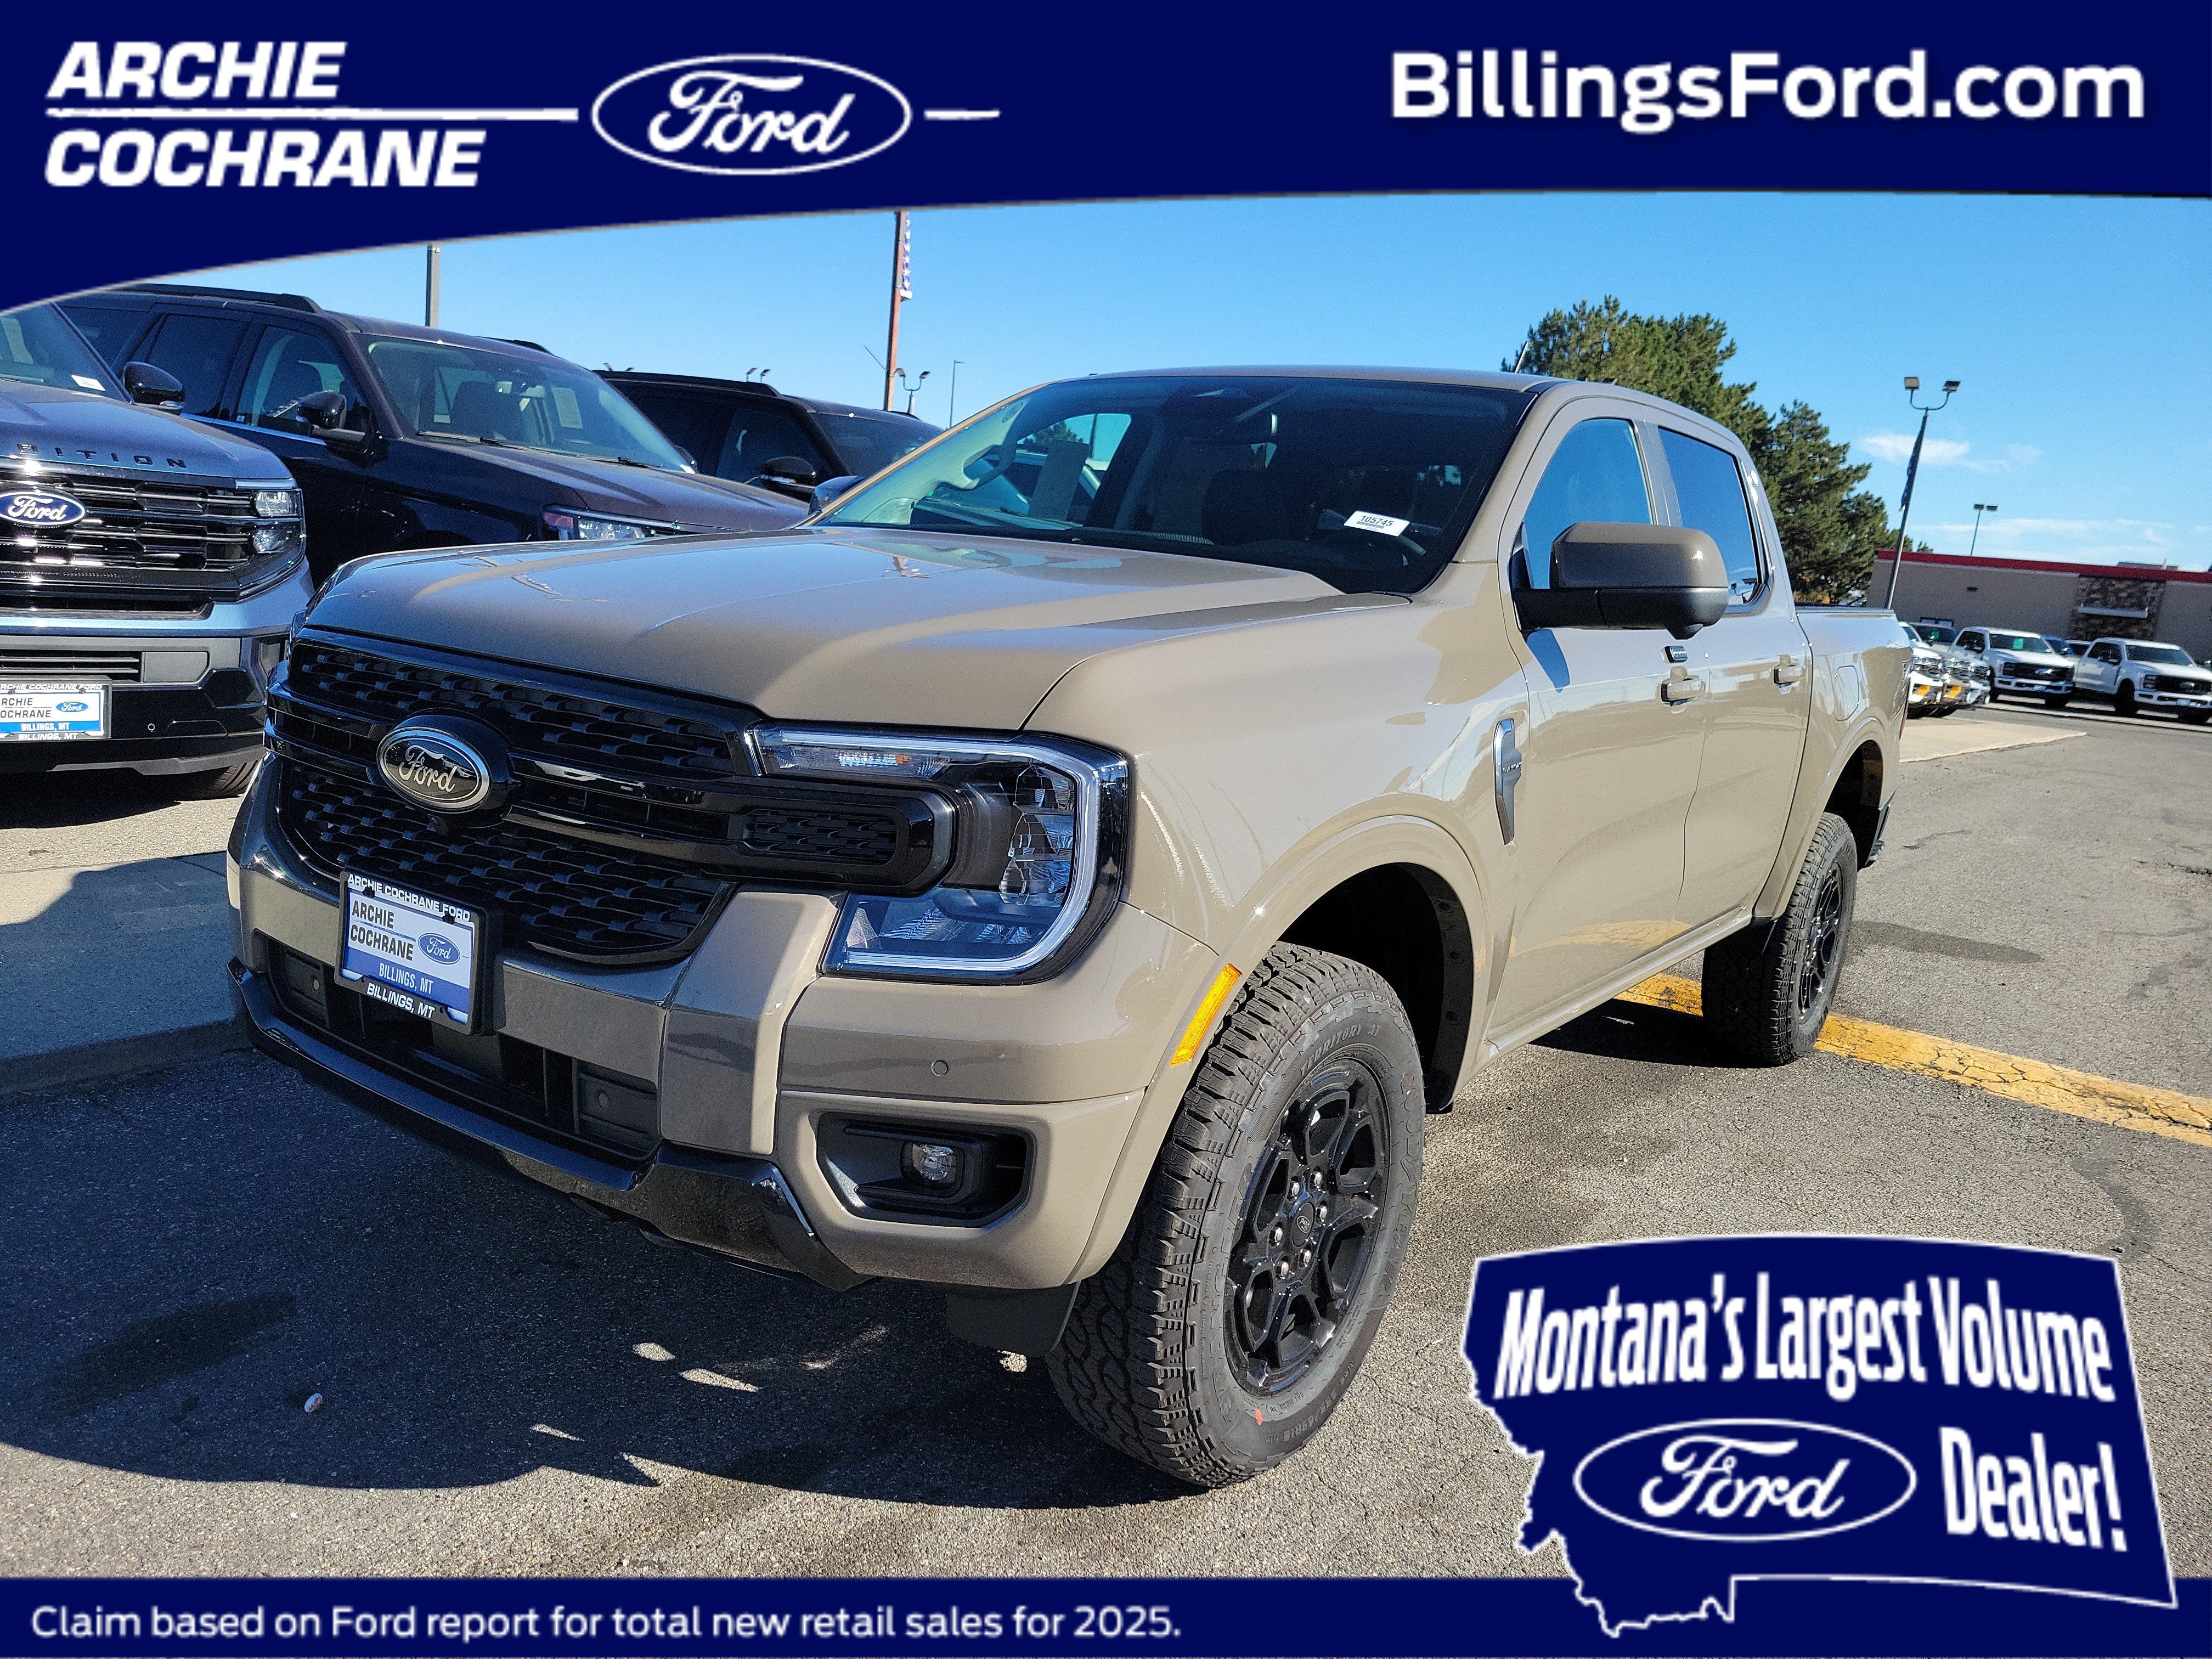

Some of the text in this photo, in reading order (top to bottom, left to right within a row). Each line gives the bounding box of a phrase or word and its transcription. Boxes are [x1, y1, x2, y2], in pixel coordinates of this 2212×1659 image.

[8, 495, 68, 520] Ford
[1361, 515, 1394, 527] 105745
[0, 710, 52, 718] OCHRANE
[61, 702, 83, 712] Ford
[21, 723, 57, 731] BILLINGS,
[398, 744, 458, 793] Ford
[348, 873, 471, 922] ARCHIE COCHRANE FORD
[352, 900, 394, 929] ARCHIE
[350, 924, 414, 961] COCHRANE
[426, 936, 452, 960] Ford
[379, 962, 434, 995] BILLINGS, MT
[366, 983, 435, 1019] BILLINGS, MT
[1301, 1023, 1364, 1077] TERRITORY
[1365, 1024, 1381, 1037] AT
